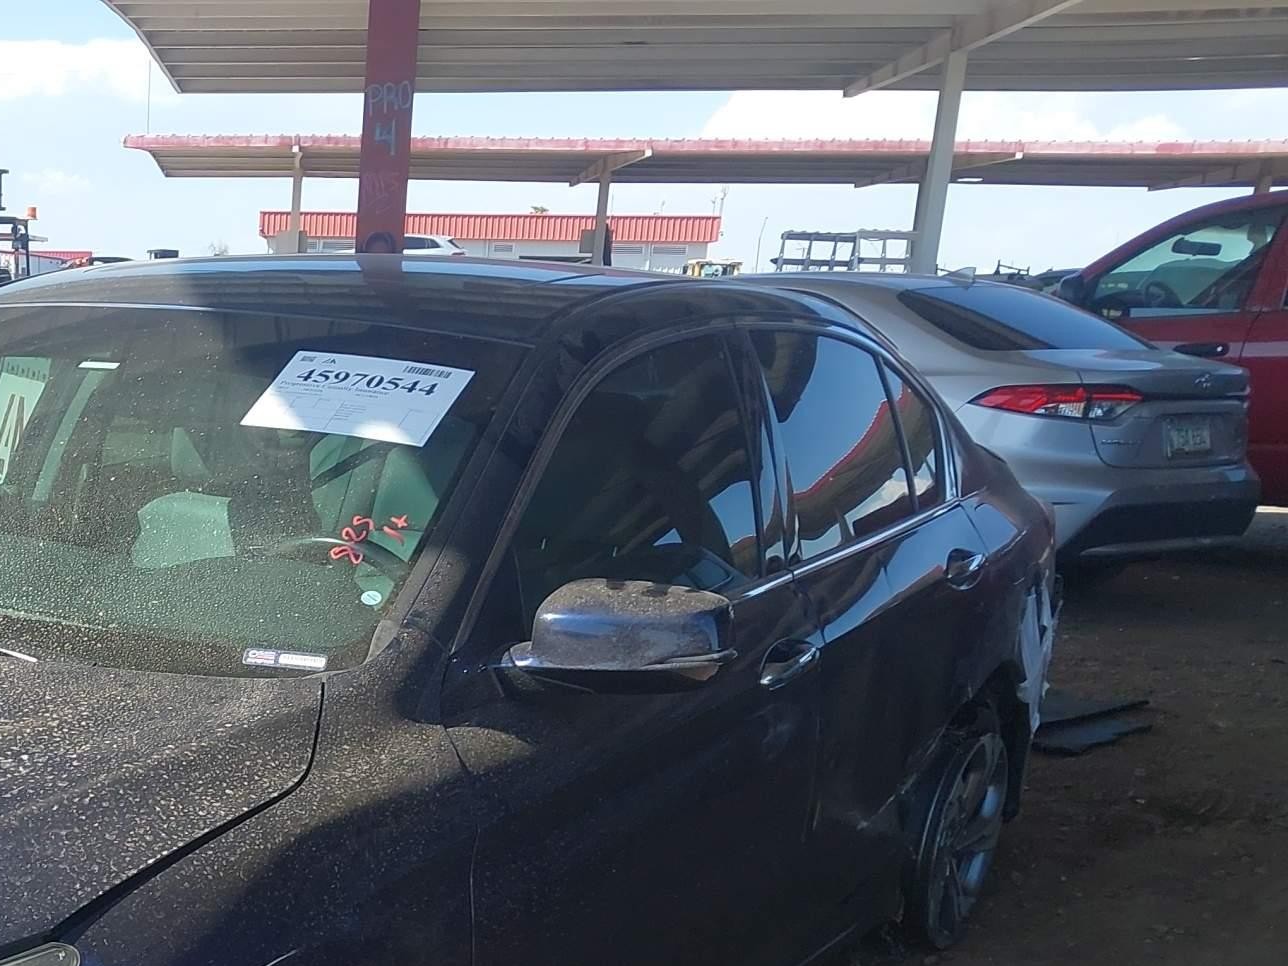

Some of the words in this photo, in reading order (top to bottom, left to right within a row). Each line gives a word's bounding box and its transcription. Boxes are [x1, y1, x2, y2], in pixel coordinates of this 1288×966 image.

[366, 81, 412, 116] PRO
[376, 118, 397, 156] 4
[296, 368, 439, 396] 45970544
